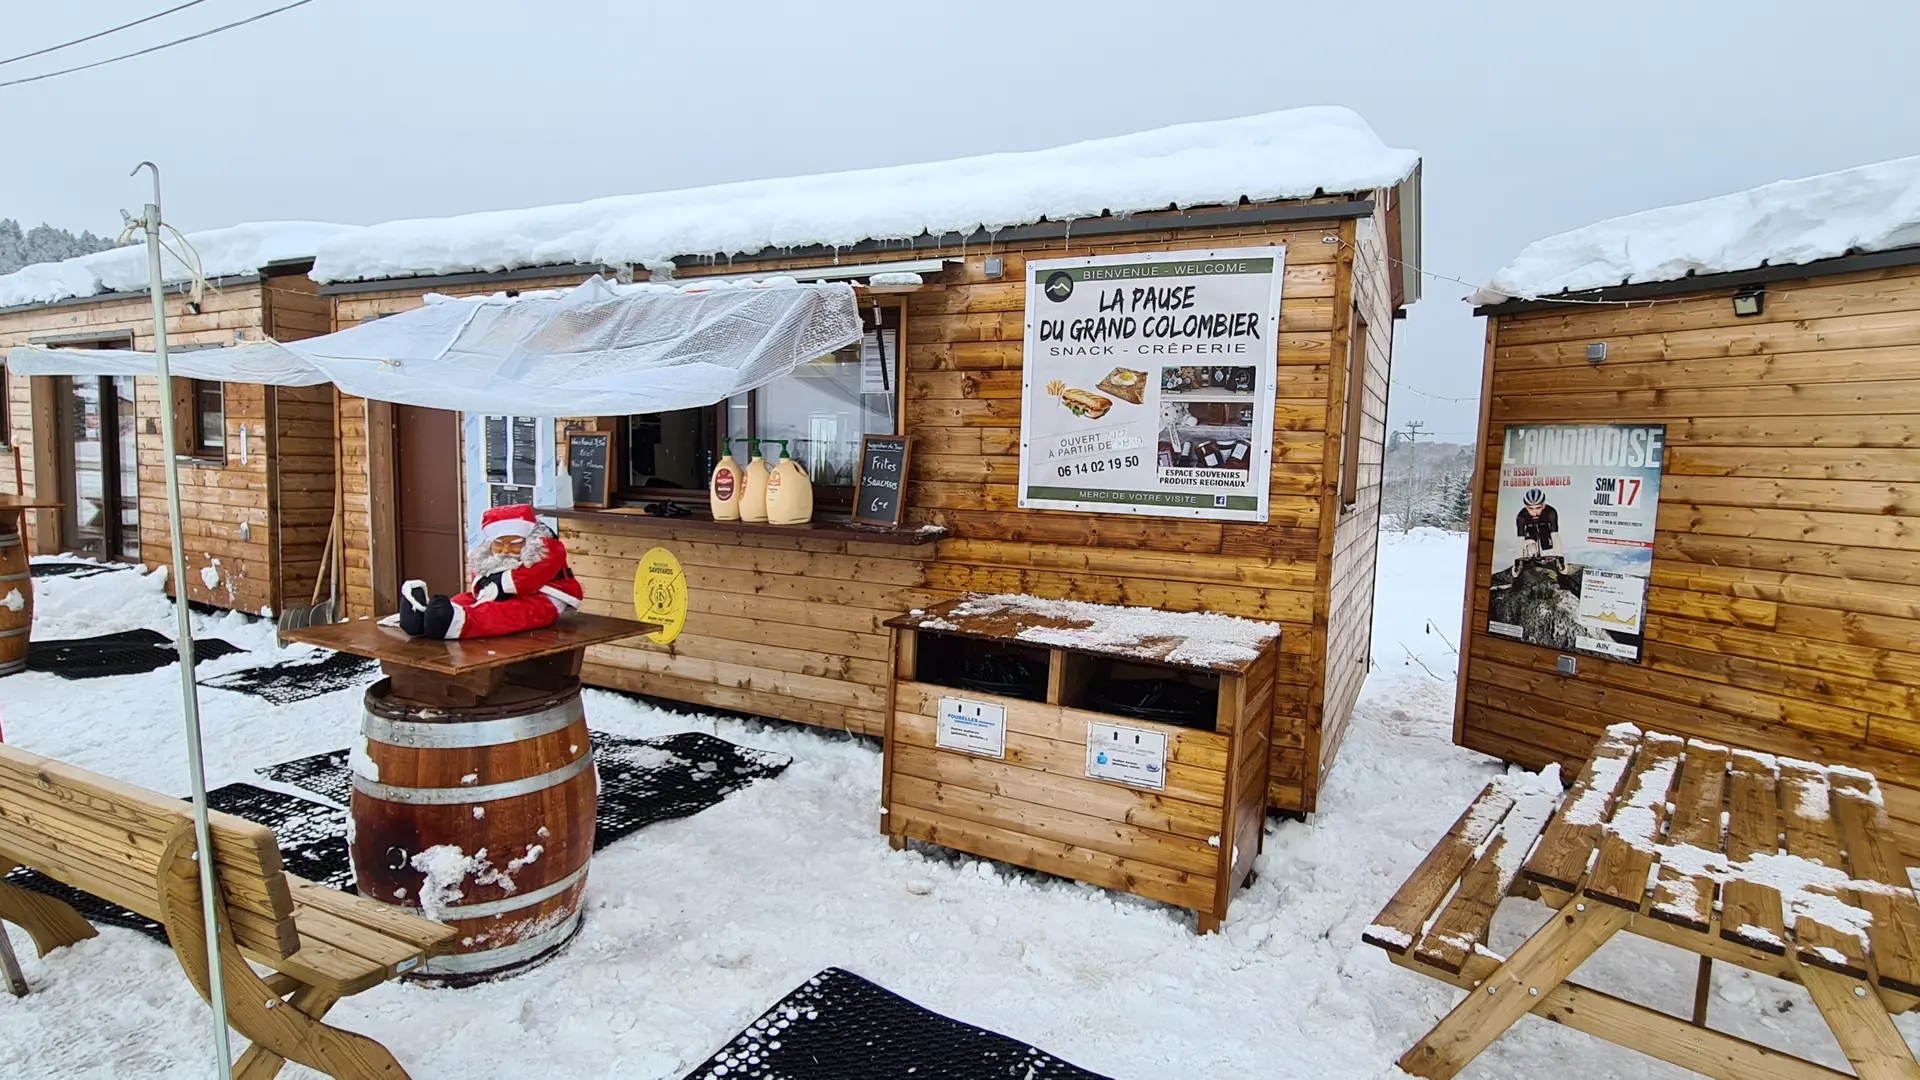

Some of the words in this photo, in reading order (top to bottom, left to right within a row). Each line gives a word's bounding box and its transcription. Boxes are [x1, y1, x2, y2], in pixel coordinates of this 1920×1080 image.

[1083, 266, 1159, 280] BIENVENUE
[1174, 263, 1246, 275] WELCOME
[1099, 288, 1124, 314] LA
[1131, 286, 1196, 313] PAUSE
[1040, 319, 1064, 342] DU
[1070, 316, 1136, 343] GRAND
[1143, 312, 1260, 340] COLOMBIER
[1050, 345, 1114, 356] SNACK
[1137, 342, 1246, 355] CRÊPERIE
[1060, 433, 1101, 448] OUVERT
[1048, 449, 1054, 459] À
[1058, 444, 1094, 457] PARTIR
[1098, 441, 1112, 451] DE
[872, 455, 896, 471] Frites
[1057, 465, 1071, 477] 06
[1075, 463, 1088, 474] 14
[1090, 460, 1105, 473] 02
[1108, 458, 1122, 470] 19
[1124, 455, 1139, 468] 50
[1165, 469, 1194, 477] ESPACE
[1195, 470, 1240, 479] SOUVENIRS
[1513, 467, 1537, 476] ASSAUT
[867, 476, 898, 490] Saucisses
[1159, 477, 1198, 486] PRODUITS
[1199, 478, 1246, 488] REGIONAUX
[1510, 478, 1531, 487] GRAND
[1532, 476, 1571, 486] COLOMBIER
[1595, 478, 1616, 492] SAM
[1078, 490, 1109, 499] MERCI
[1112, 492, 1126, 500] DE
[1129, 493, 1161, 502] VOTRE
[1164, 495, 1197, 504] VISITE
[1618, 479, 1641, 506] 17
